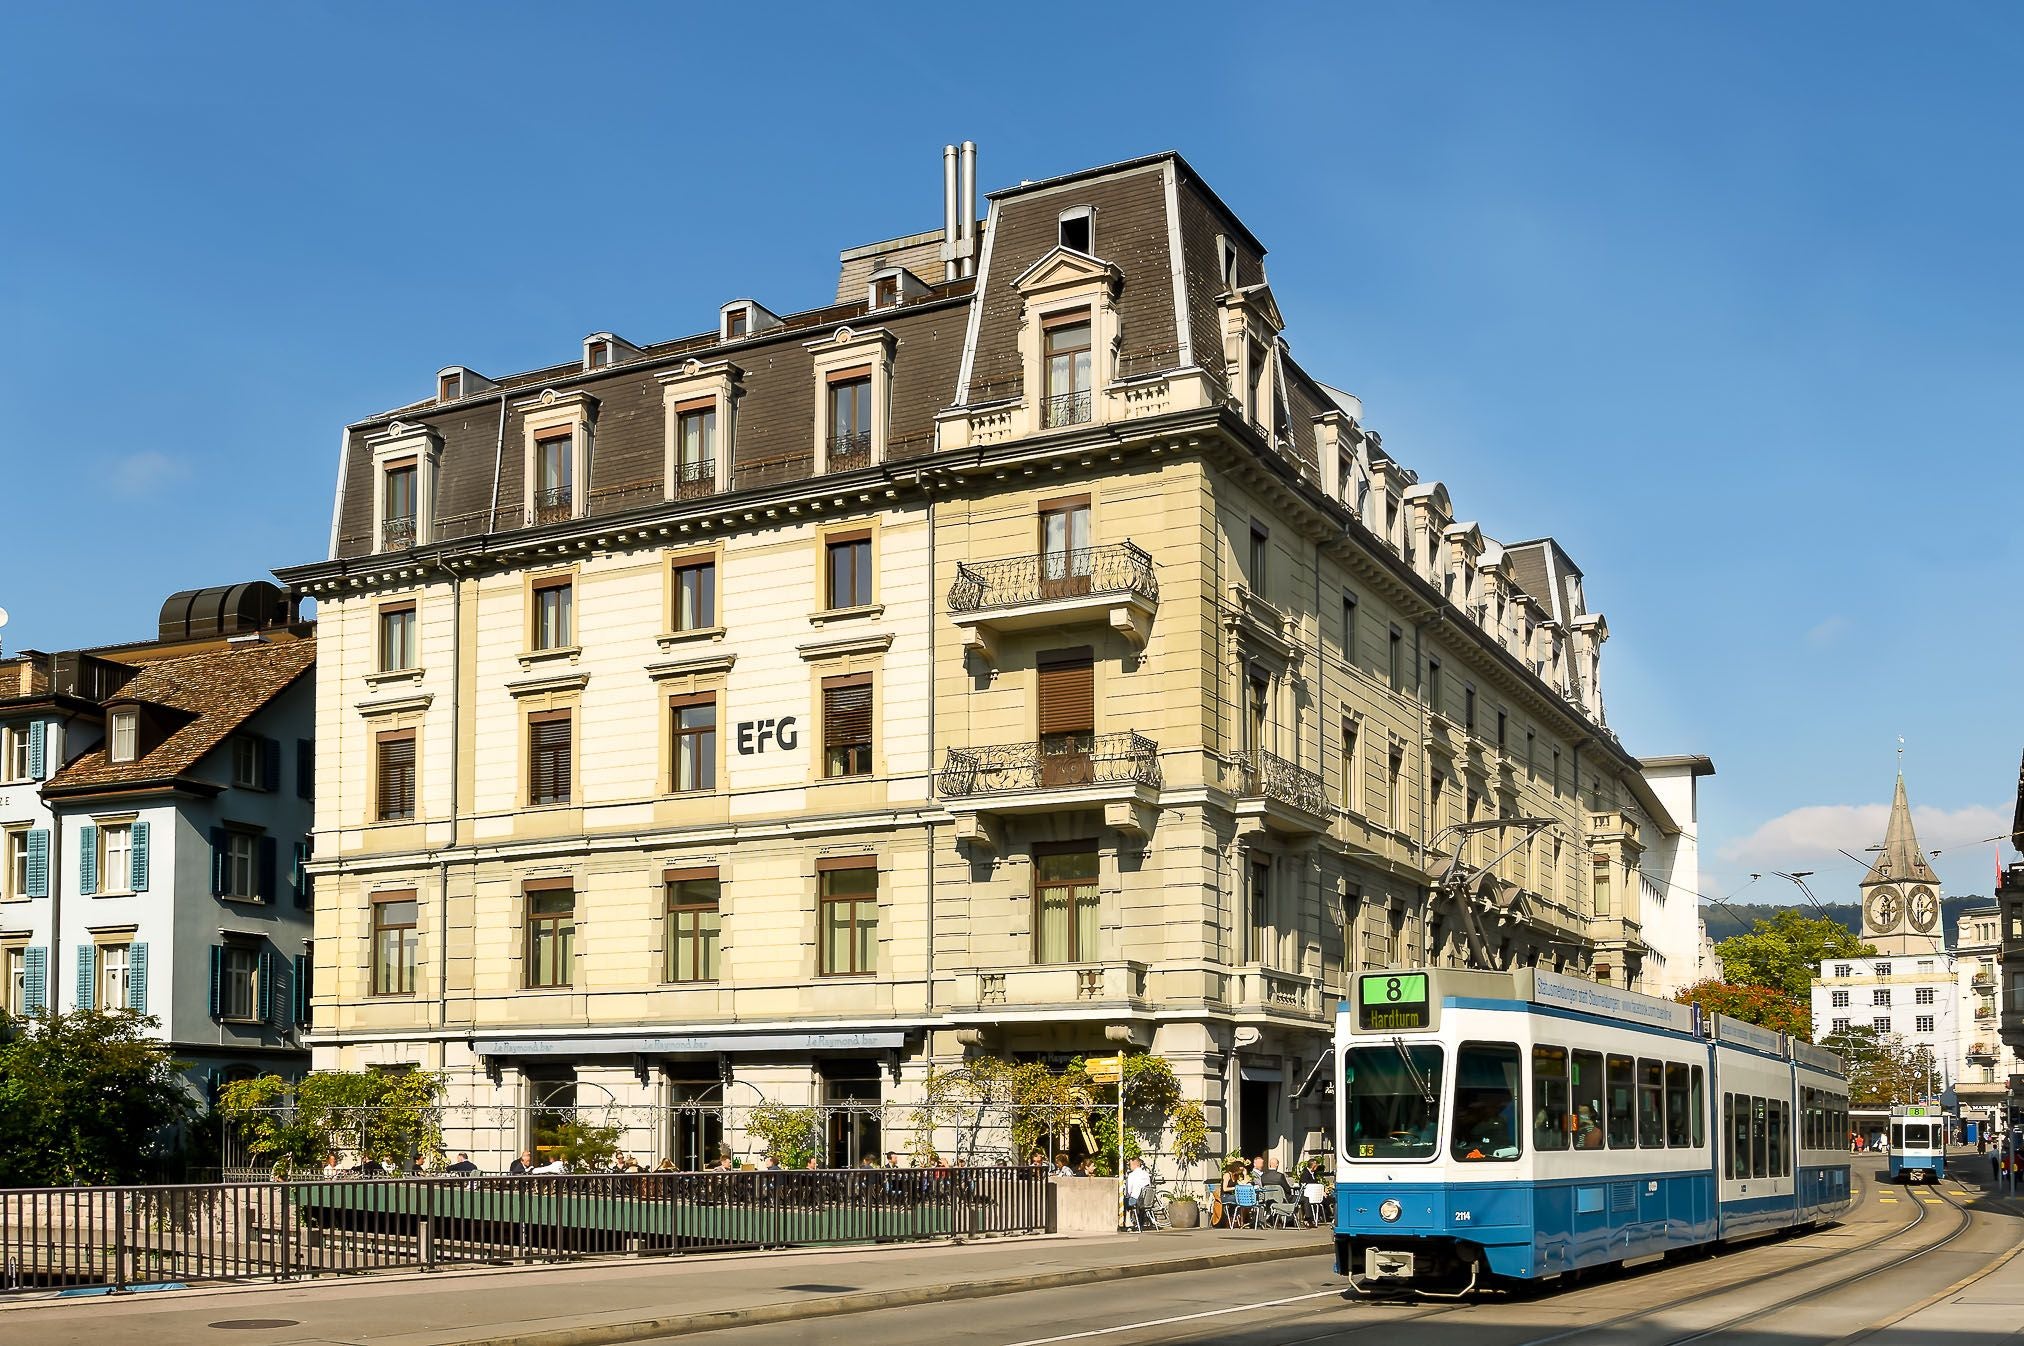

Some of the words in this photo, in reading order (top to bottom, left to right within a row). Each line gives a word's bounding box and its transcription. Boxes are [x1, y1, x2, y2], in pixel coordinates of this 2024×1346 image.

[737, 716, 797, 755] EFG
[1386, 978, 1402, 1002] 8
[1371, 1009, 1419, 1028] Hardturm
[693, 1038, 708, 1049] bar
[862, 1034, 878, 1045] bar
[540, 1041, 553, 1052] bar
[1455, 1211, 1471, 1221] 2114
